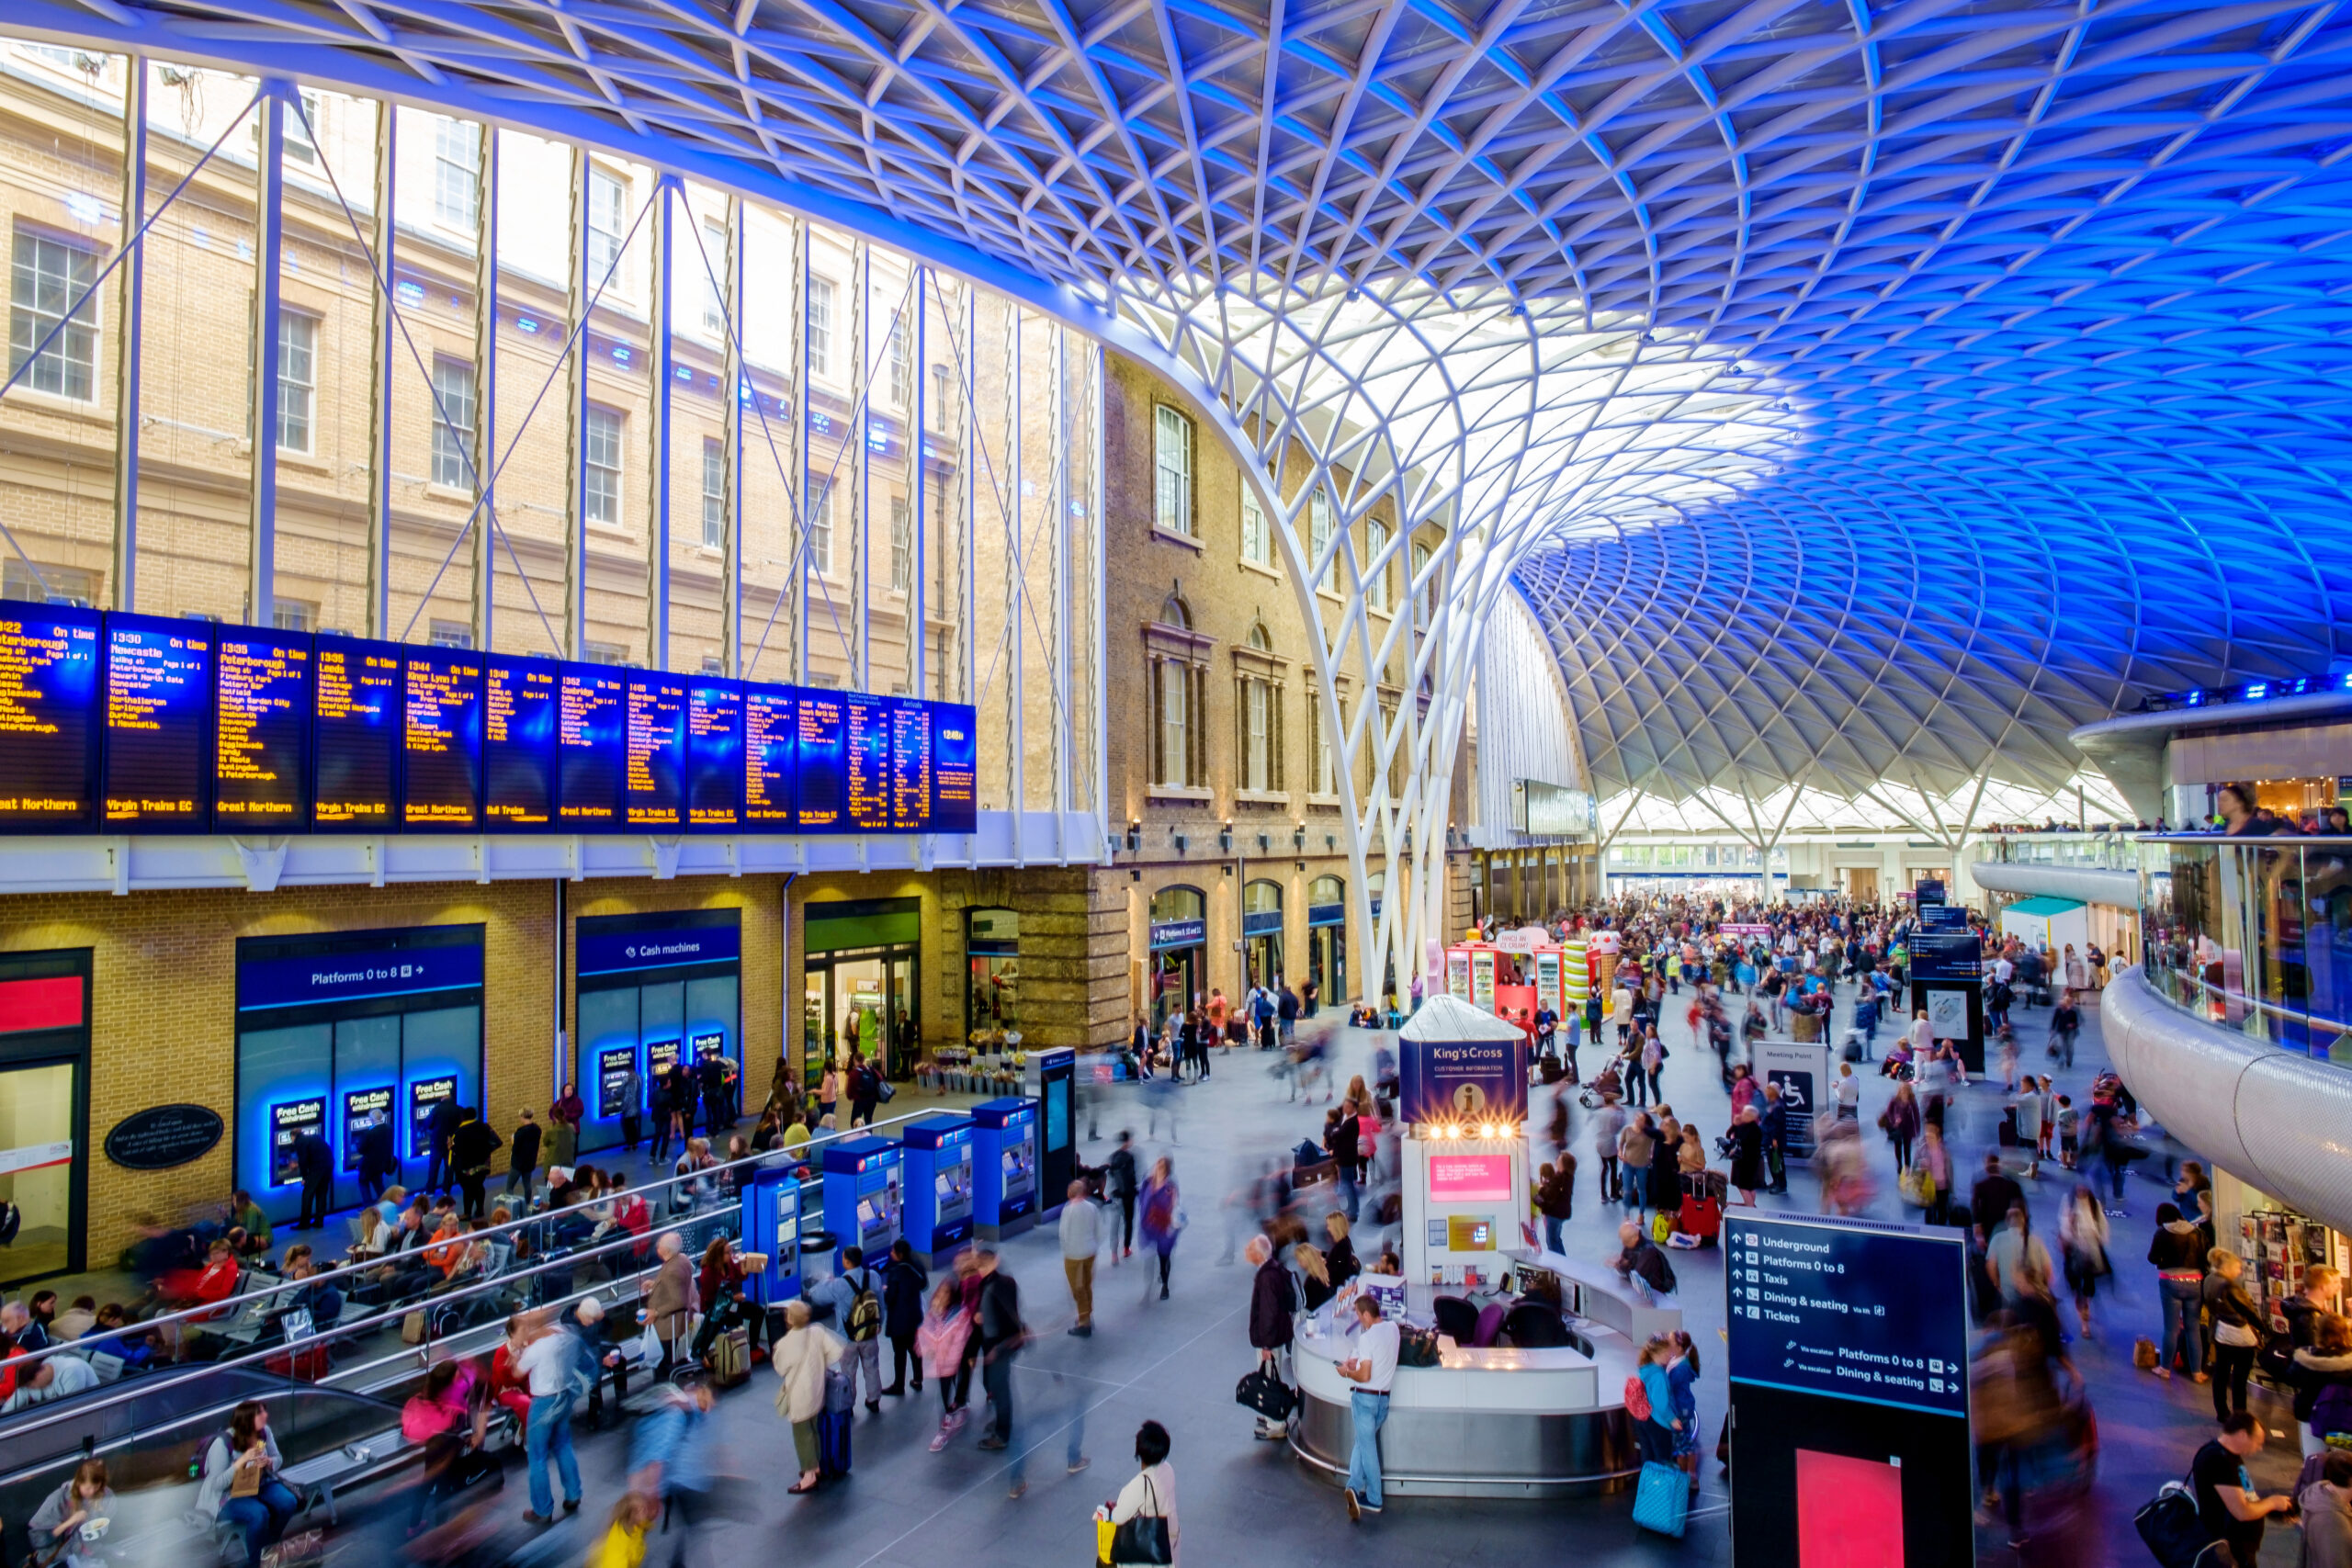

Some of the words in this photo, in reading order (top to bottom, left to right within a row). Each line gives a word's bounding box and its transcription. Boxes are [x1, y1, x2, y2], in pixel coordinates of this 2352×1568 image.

[53, 626, 67, 637] On
[73, 628, 95, 639] time
[170, 637, 183, 649] On
[187, 638, 207, 651] time
[47, 649, 63, 660] Page
[110, 643, 163, 658] Newcastle
[273, 648, 285, 659] On
[288, 649, 307, 660] time
[31, 656, 51, 666] Park
[164, 660, 179, 669] Page
[220, 653, 286, 670] Peterborough
[366, 656, 378, 667] On
[379, 658, 397, 669] time
[110, 663, 165, 675] Peterborough
[267, 669, 281, 678] Page
[319, 662, 345, 674] Leeds
[450, 665, 460, 674] On
[110, 671, 138, 680] Newark
[141, 673, 164, 682] North
[166, 675, 184, 684] Gate
[220, 671, 253, 682] Finsbury
[255, 674, 272, 683] Park
[109, 679, 151, 689] Doncaster
[109, 687, 129, 695] York
[109, 695, 166, 706] Northallerton
[274, 698, 290, 708] City
[109, 703, 154, 714] Darlington
[247, 705, 267, 713] North
[219, 717, 256, 728] Stevenage
[219, 725, 247, 734] Hitchin
[219, 739, 264, 750] Biggleswade
[218, 762, 259, 772] Huntingdon
[22, 797, 76, 810] Northern
[107, 799, 138, 811] Virgin
[141, 799, 175, 811] Trains
[179, 801, 192, 811] EC
[218, 801, 245, 812] Great
[249, 801, 292, 812] Northern
[316, 802, 341, 813] Virgin
[345, 802, 371, 813] Trains
[374, 803, 385, 813] EC
[406, 804, 428, 814] Great
[432, 804, 467, 814] Northern
[640, 944, 661, 956] Cash
[662, 942, 699, 954] machines
[312, 971, 364, 985] Platforms
[367, 968, 374, 980] 0
[376, 969, 388, 979] to
[390, 967, 397, 978] 8
[664, 1043, 678, 1052] Cash
[617, 1052, 632, 1060] Cash
[1433, 1047, 1468, 1061] King's
[1469, 1047, 1502, 1058] Cross
[1767, 1051, 1793, 1059] Meeting
[415, 1083, 433, 1095] Free
[434, 1079, 453, 1091] Cash
[349, 1095, 368, 1106] Free
[368, 1090, 390, 1102] Cash
[277, 1105, 297, 1119] Free
[298, 1102, 320, 1114] Cash
[1763, 1236, 1829, 1254] Underground
[1763, 1255, 1812, 1271] Platforms
[1814, 1261, 1821, 1271] 0
[1824, 1262, 1835, 1272] to
[1838, 1264, 1845, 1274] 8
[1763, 1273, 1788, 1285] Taxis
[1764, 1291, 1796, 1306] Dining
[1799, 1295, 1808, 1306] &
[1810, 1297, 1848, 1314] seating
[1764, 1309, 1800, 1324] Tickets
[1801, 1345, 1809, 1353] Via
[1810, 1347, 1834, 1356] escalator
[1838, 1347, 1889, 1365] Platforms
[1892, 1356, 1899, 1366] 0
[1902, 1357, 1914, 1368] to
[1916, 1359, 1924, 1369] 8
[1798, 1363, 1806, 1371] Via
[1807, 1364, 1832, 1374] escalator
[1837, 1365, 1871, 1382] Dining
[1873, 1371, 1883, 1382] &
[1884, 1373, 1925, 1390] seating
